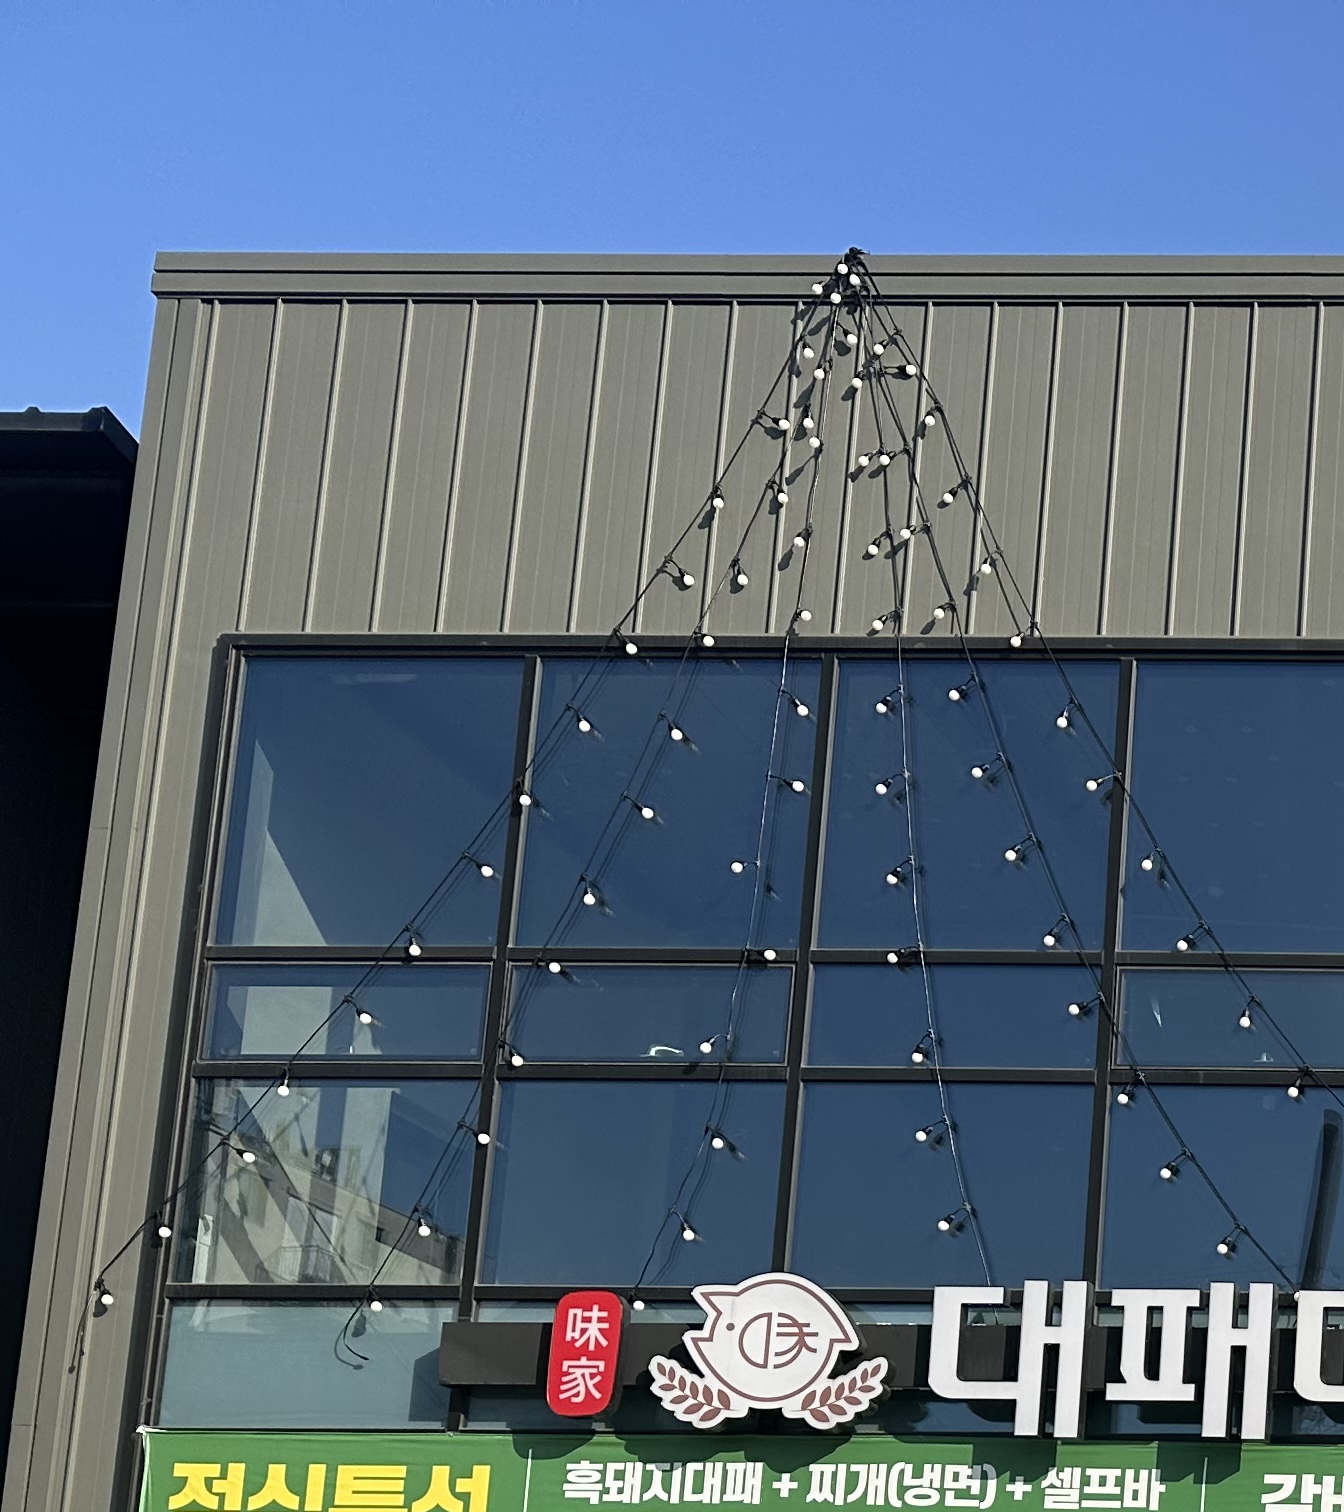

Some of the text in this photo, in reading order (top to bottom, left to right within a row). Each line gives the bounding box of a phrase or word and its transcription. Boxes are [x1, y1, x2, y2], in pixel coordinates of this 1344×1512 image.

[558, 1306, 611, 1404] 味家
[562, 1461, 762, 1506] 흑돼지대패
[805, 1462, 996, 1512] 찌개(냉면)
[1040, 1468, 1166, 1511] 셀프바
